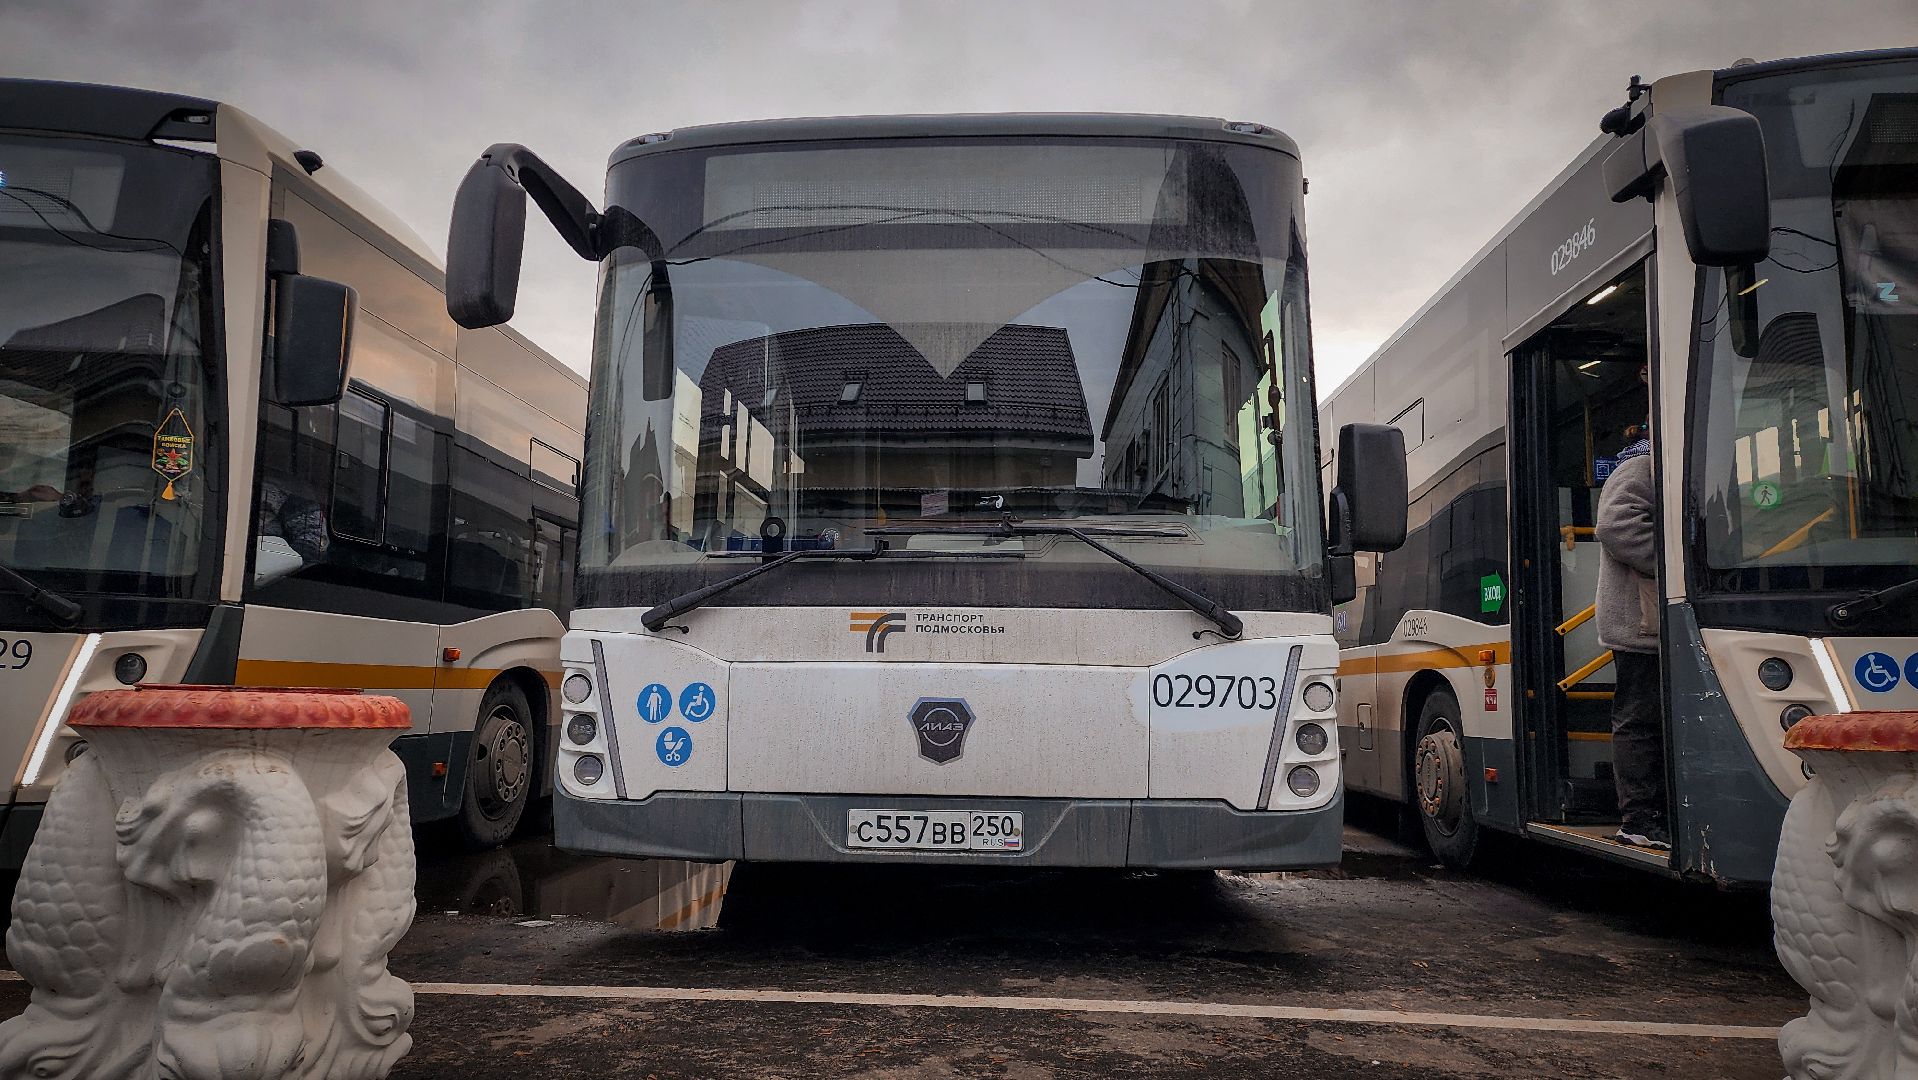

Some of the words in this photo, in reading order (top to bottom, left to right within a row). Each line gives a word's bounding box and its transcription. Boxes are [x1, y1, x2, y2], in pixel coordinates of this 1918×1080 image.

[1551, 217, 1596, 275] 029846
[915, 613, 984, 623] ТРАНСПОРТ
[915, 624, 1005, 634] ПОДМОСКОВЬЯ
[1152, 673, 1277, 710] 029703
[919, 722, 964, 731] ЛИАЗ
[857, 814, 966, 845] С557ВВ
[972, 815, 1014, 837] 250
[982, 838, 1005, 847] RUS
